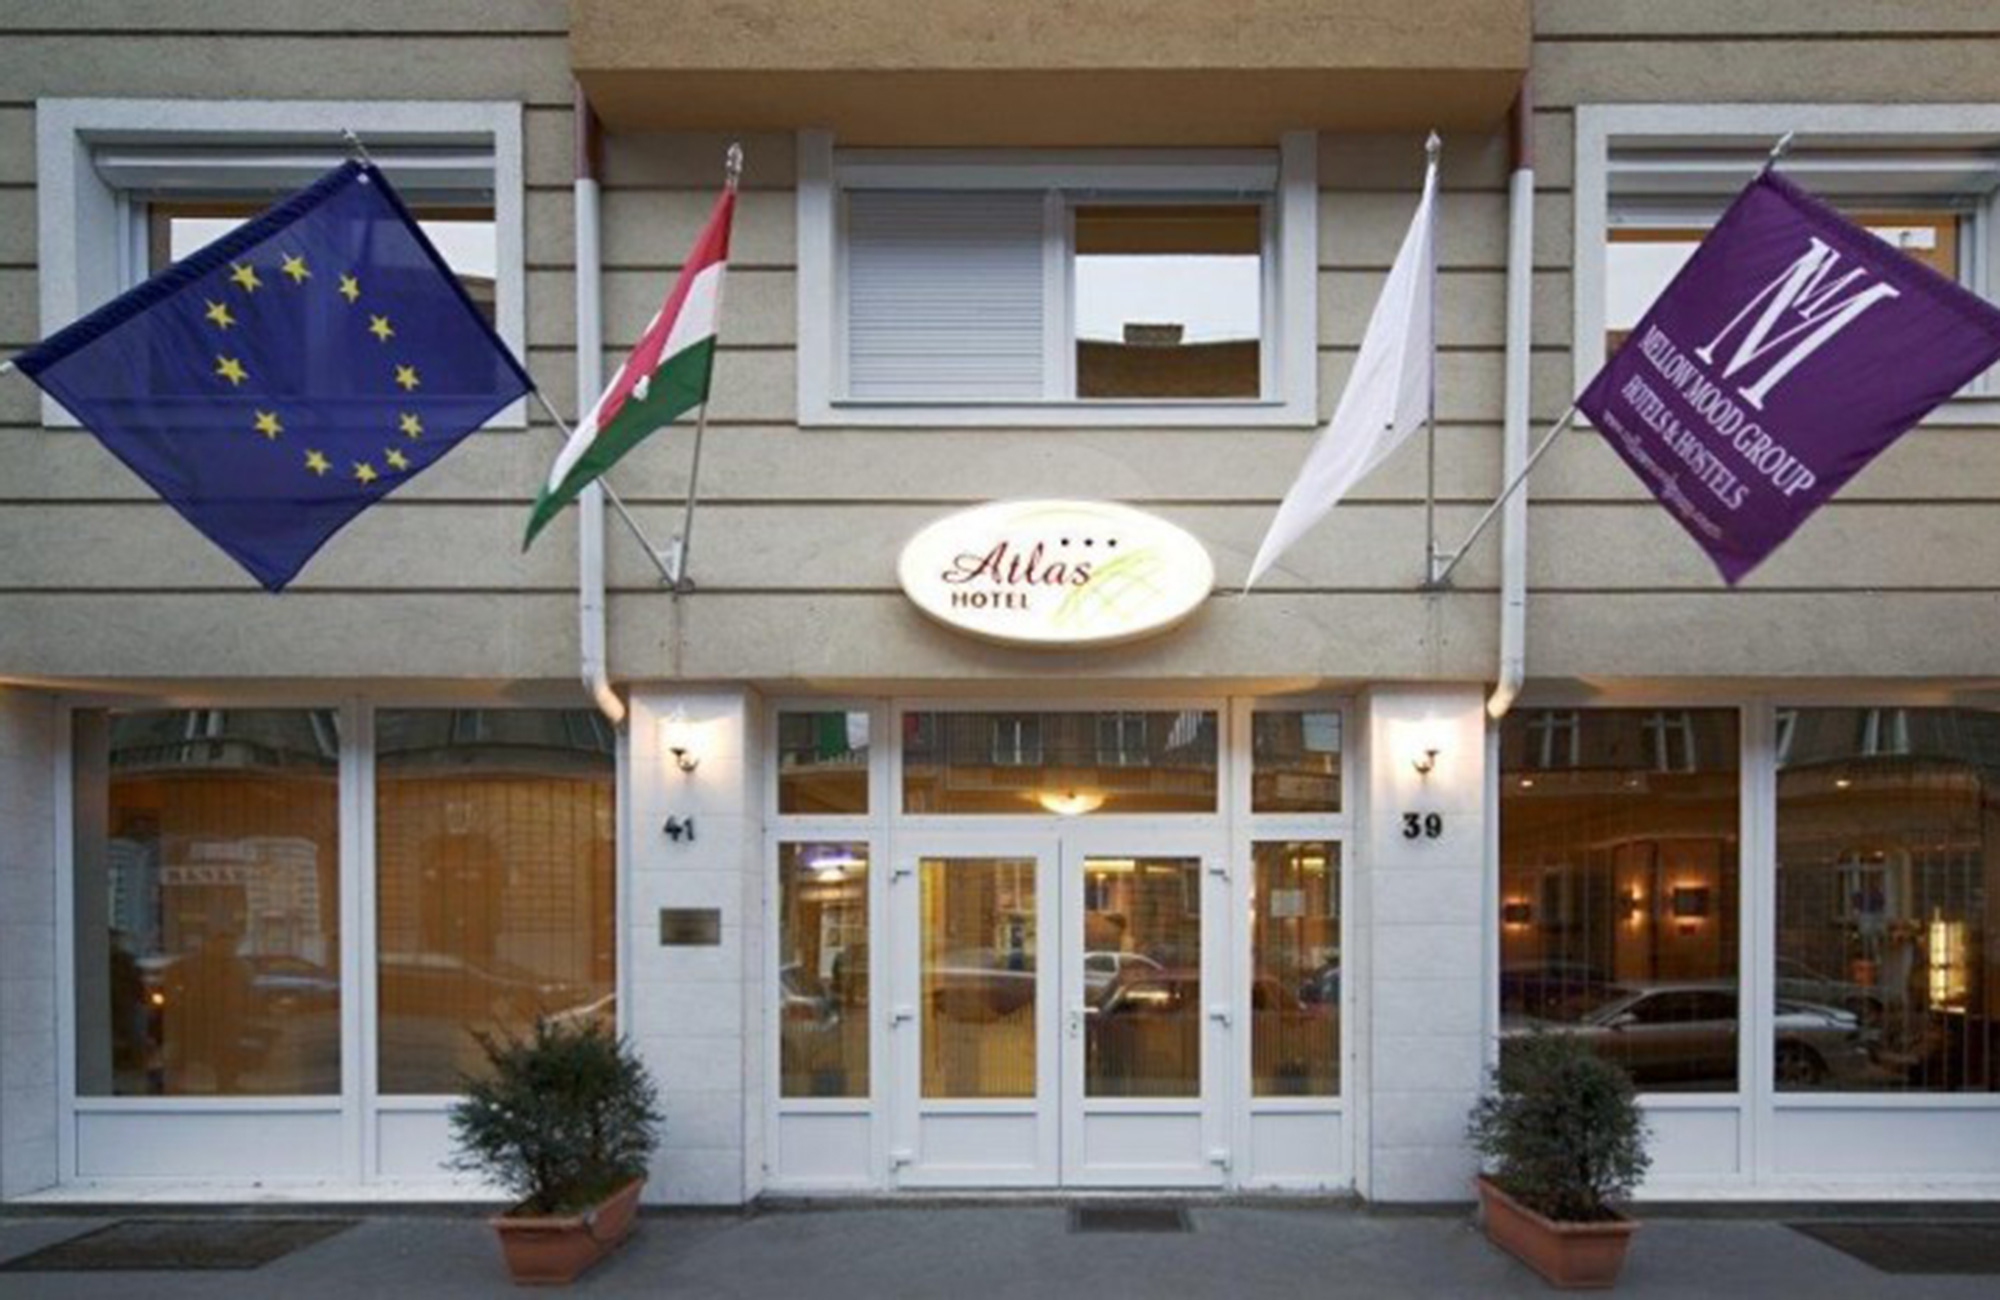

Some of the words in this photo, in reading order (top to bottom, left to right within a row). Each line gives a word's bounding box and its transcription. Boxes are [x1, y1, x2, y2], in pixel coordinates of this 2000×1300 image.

[1638, 325, 1698, 390] MELLOW
[1682, 374, 1745, 435] MOOD
[1733, 422, 1816, 497] GROUP
[1621, 374, 1674, 434] HOTELS
[1673, 429, 1750, 510] HOSTELS
[941, 540, 1092, 586] Atlas
[950, 591, 1027, 610] HOTEL
[664, 815, 695, 842] 41
[1403, 812, 1443, 839] 39
